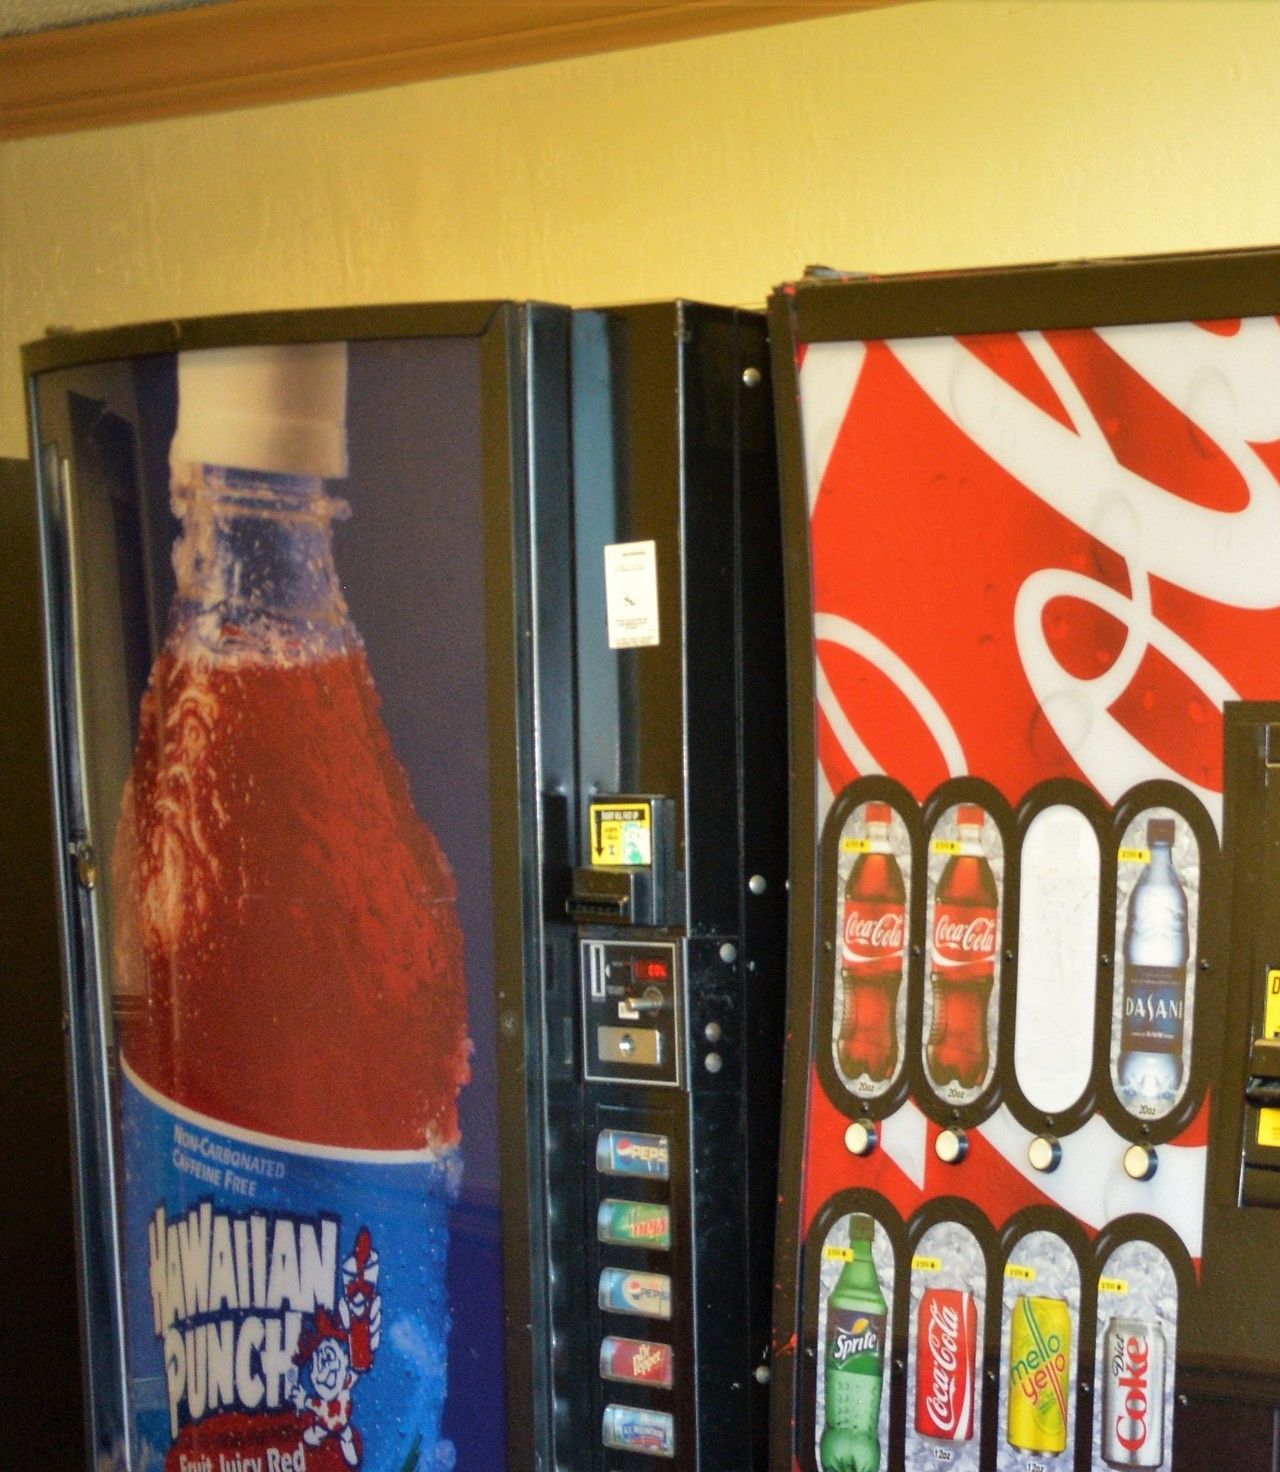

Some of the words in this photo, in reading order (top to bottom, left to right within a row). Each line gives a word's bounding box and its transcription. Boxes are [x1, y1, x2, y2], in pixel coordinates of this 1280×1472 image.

[845, 911, 903, 947] Coca-Cola
[935, 914, 995, 952] Coca-Cola
[1126, 993, 1183, 1021] DASANI
[149, 1203, 337, 1338] HAWAIIAN
[834, 1330, 877, 1360] Sprite
[926, 1298, 959, 1432] Coca-Cola
[1011, 1334, 1061, 1386] mello
[1113, 1334, 1126, 1377] Diet
[164, 1312, 303, 1440] PUNCH
[1021, 1353, 1066, 1406] yello
[1115, 1336, 1149, 1452] Coke
